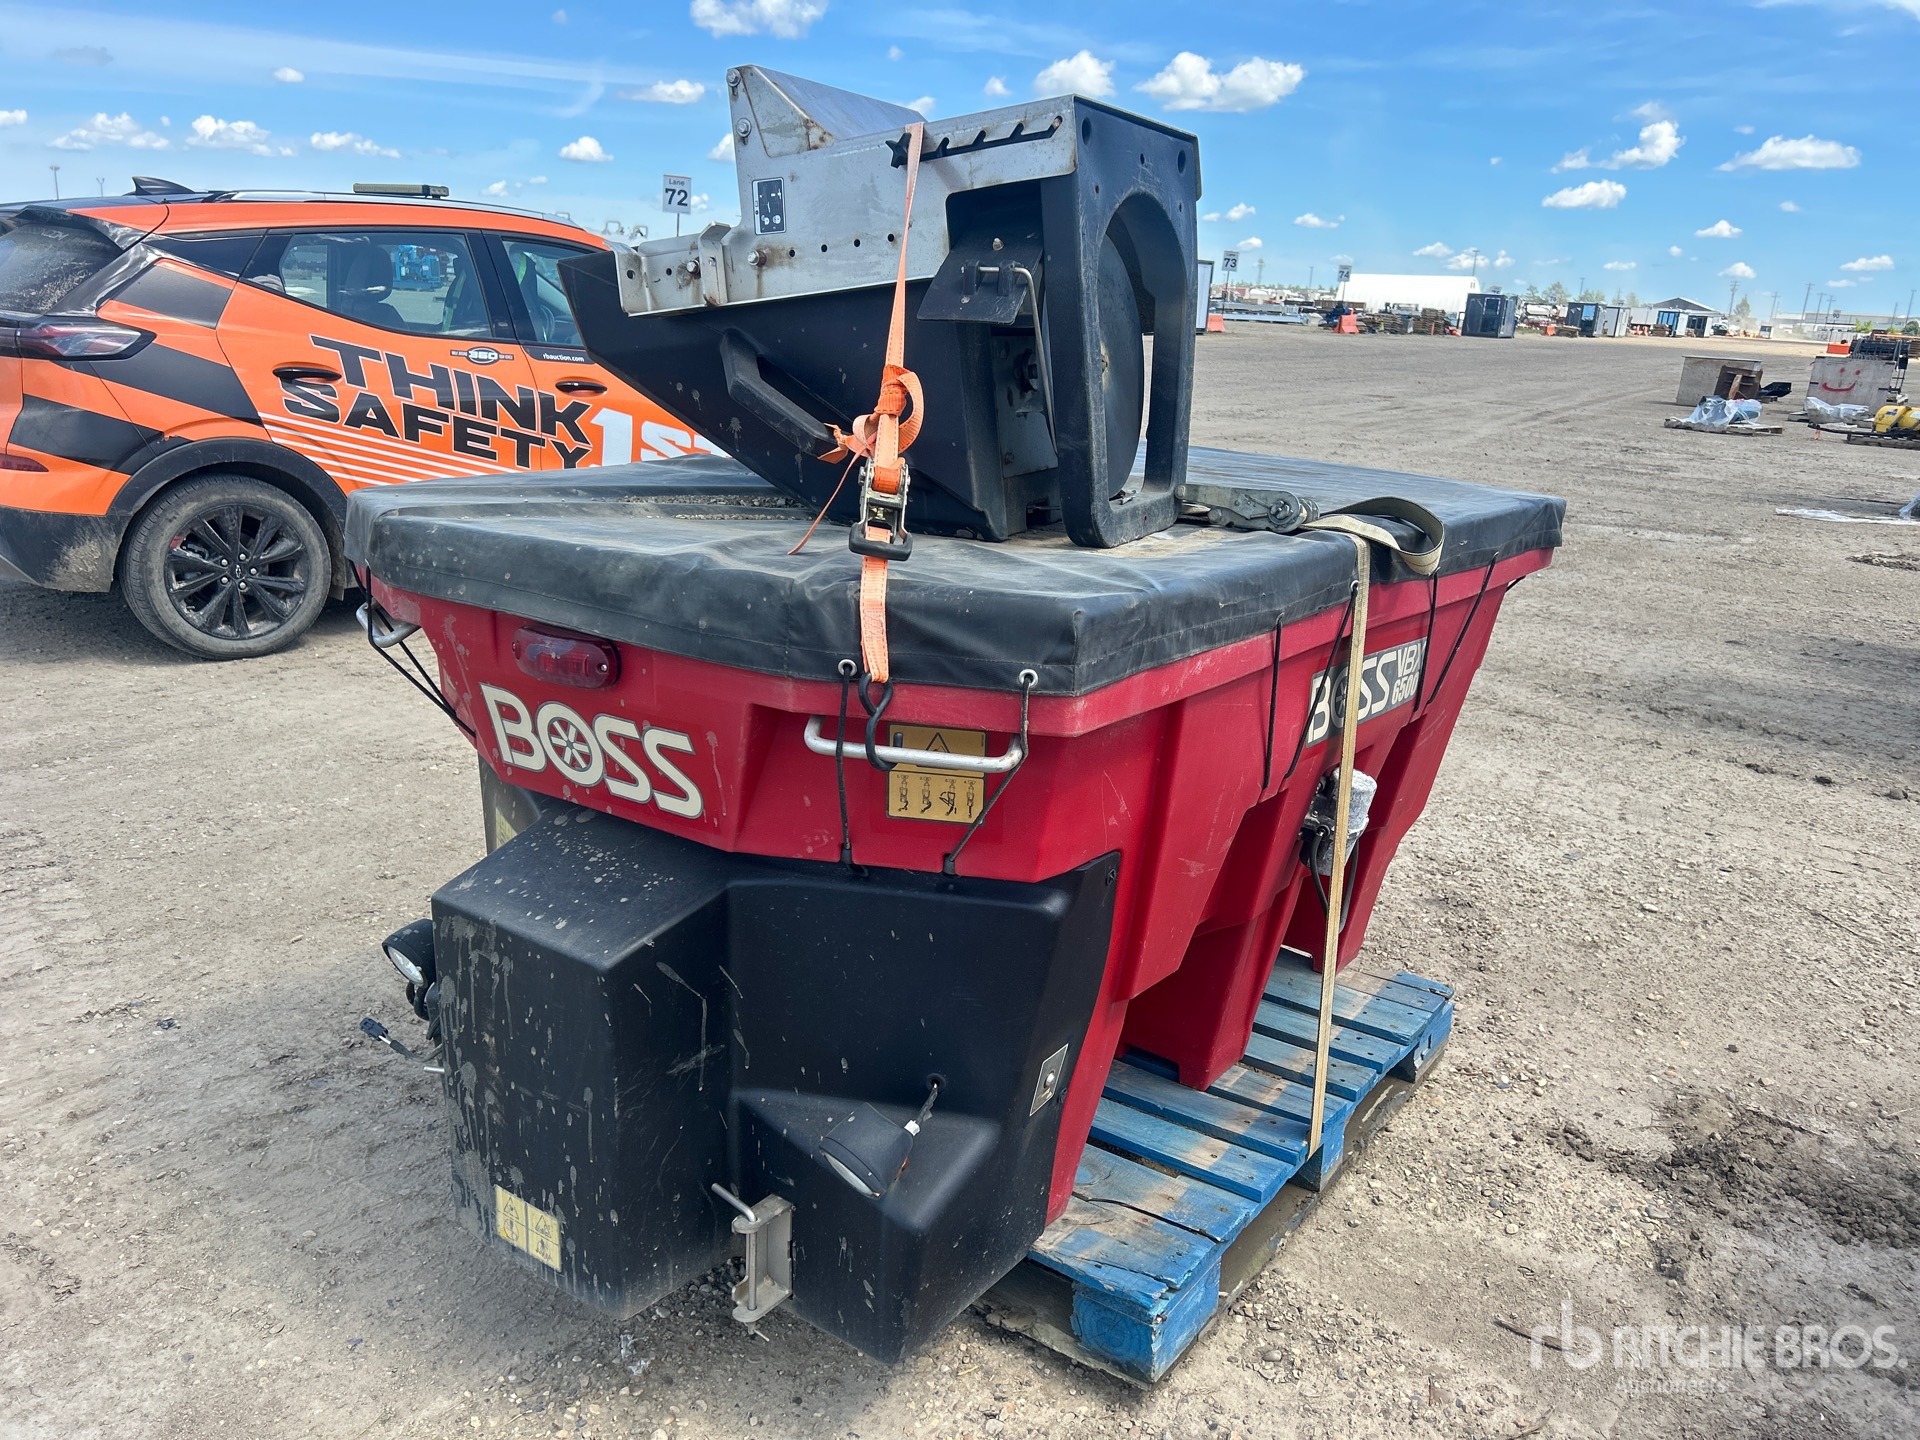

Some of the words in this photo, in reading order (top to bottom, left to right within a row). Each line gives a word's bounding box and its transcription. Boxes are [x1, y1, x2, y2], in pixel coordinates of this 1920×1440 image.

[668, 178, 685, 186] Lane
[665, 187, 688, 207] 72
[1223, 257, 1237, 268] 73
[1338, 270, 1350, 279] 74
[468, 350, 498, 360] 360
[542, 353, 585, 363] rbauction.com
[308, 334, 593, 447] THINK
[279, 377, 593, 470] SAFETY
[590, 407, 733, 467] 1S
[1391, 671, 1419, 705] 6500
[480, 682, 704, 819] BOSS
